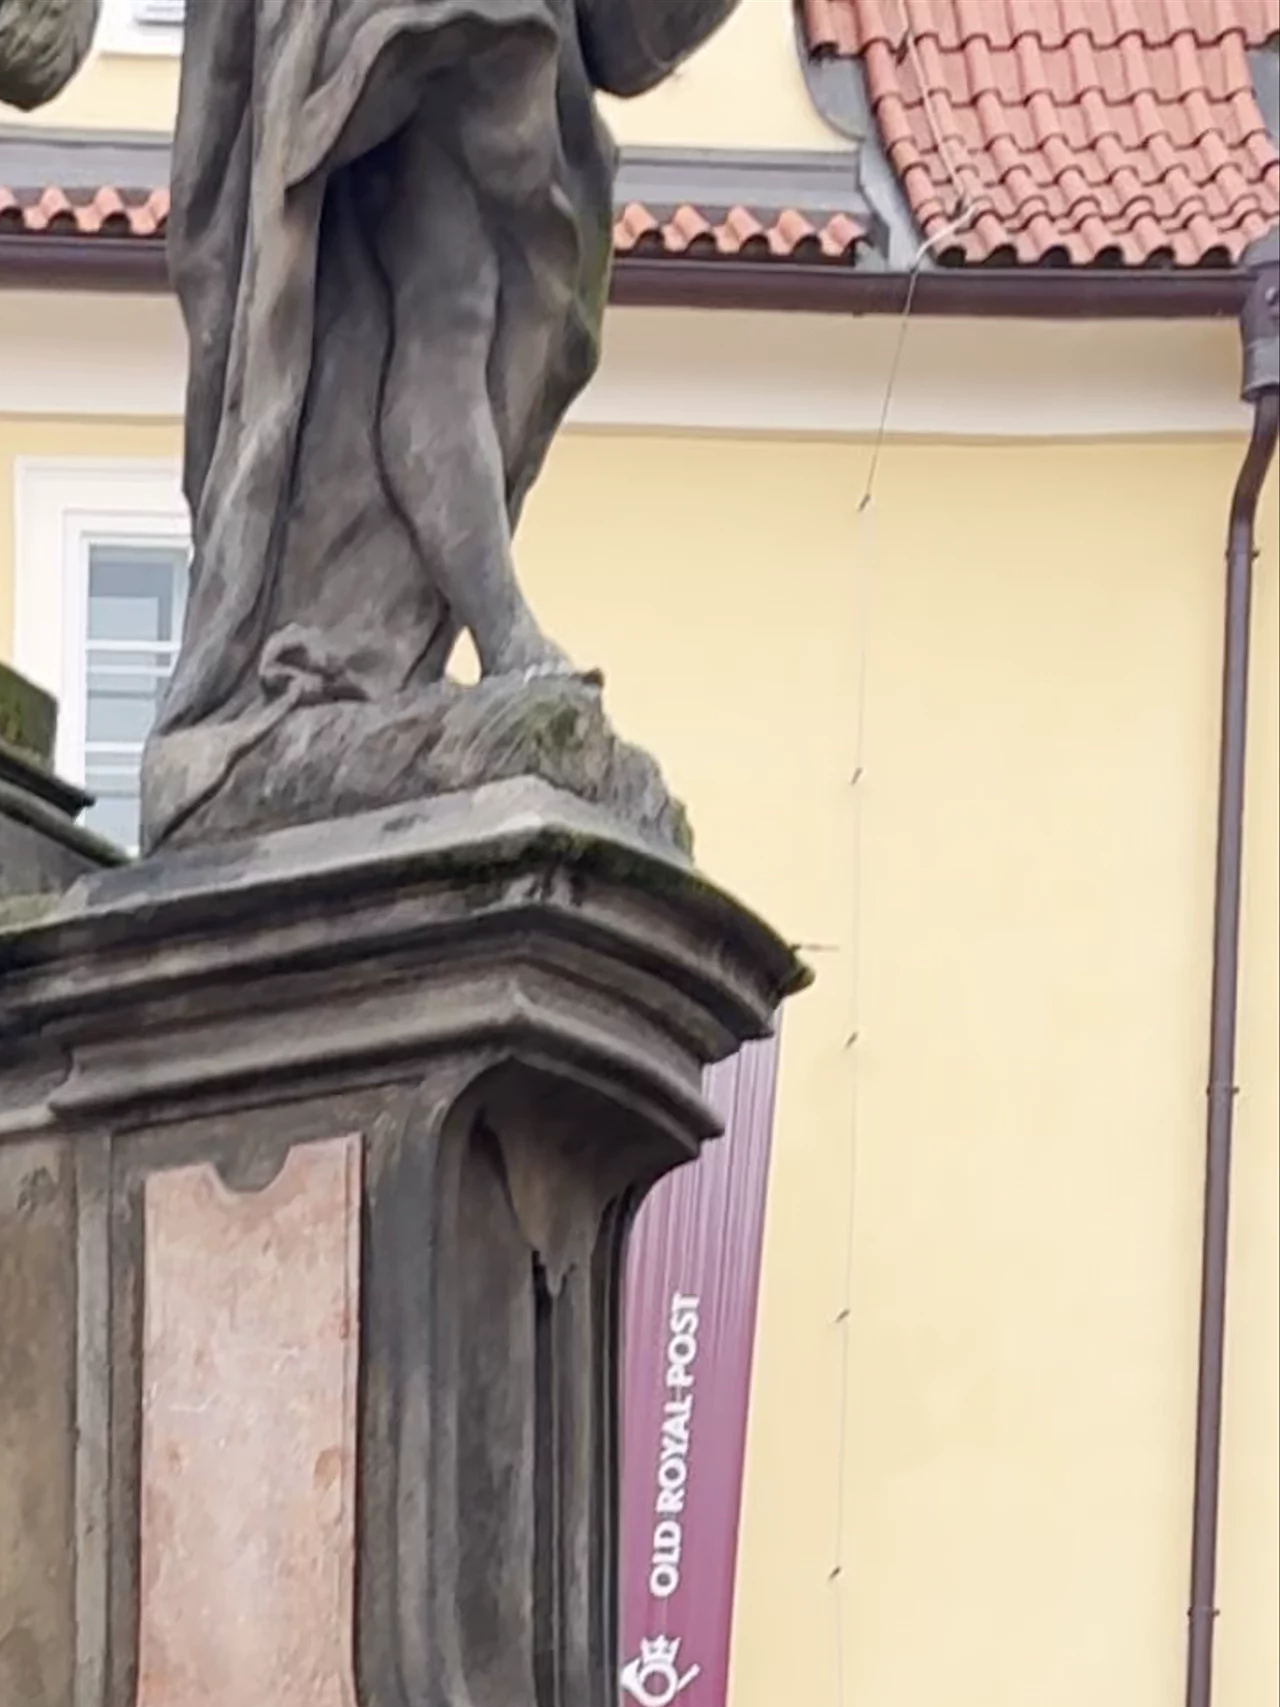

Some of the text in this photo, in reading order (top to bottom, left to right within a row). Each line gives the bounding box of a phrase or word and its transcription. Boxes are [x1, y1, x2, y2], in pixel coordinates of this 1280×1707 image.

[650, 1292, 700, 1598] OLD ROYAL POST
